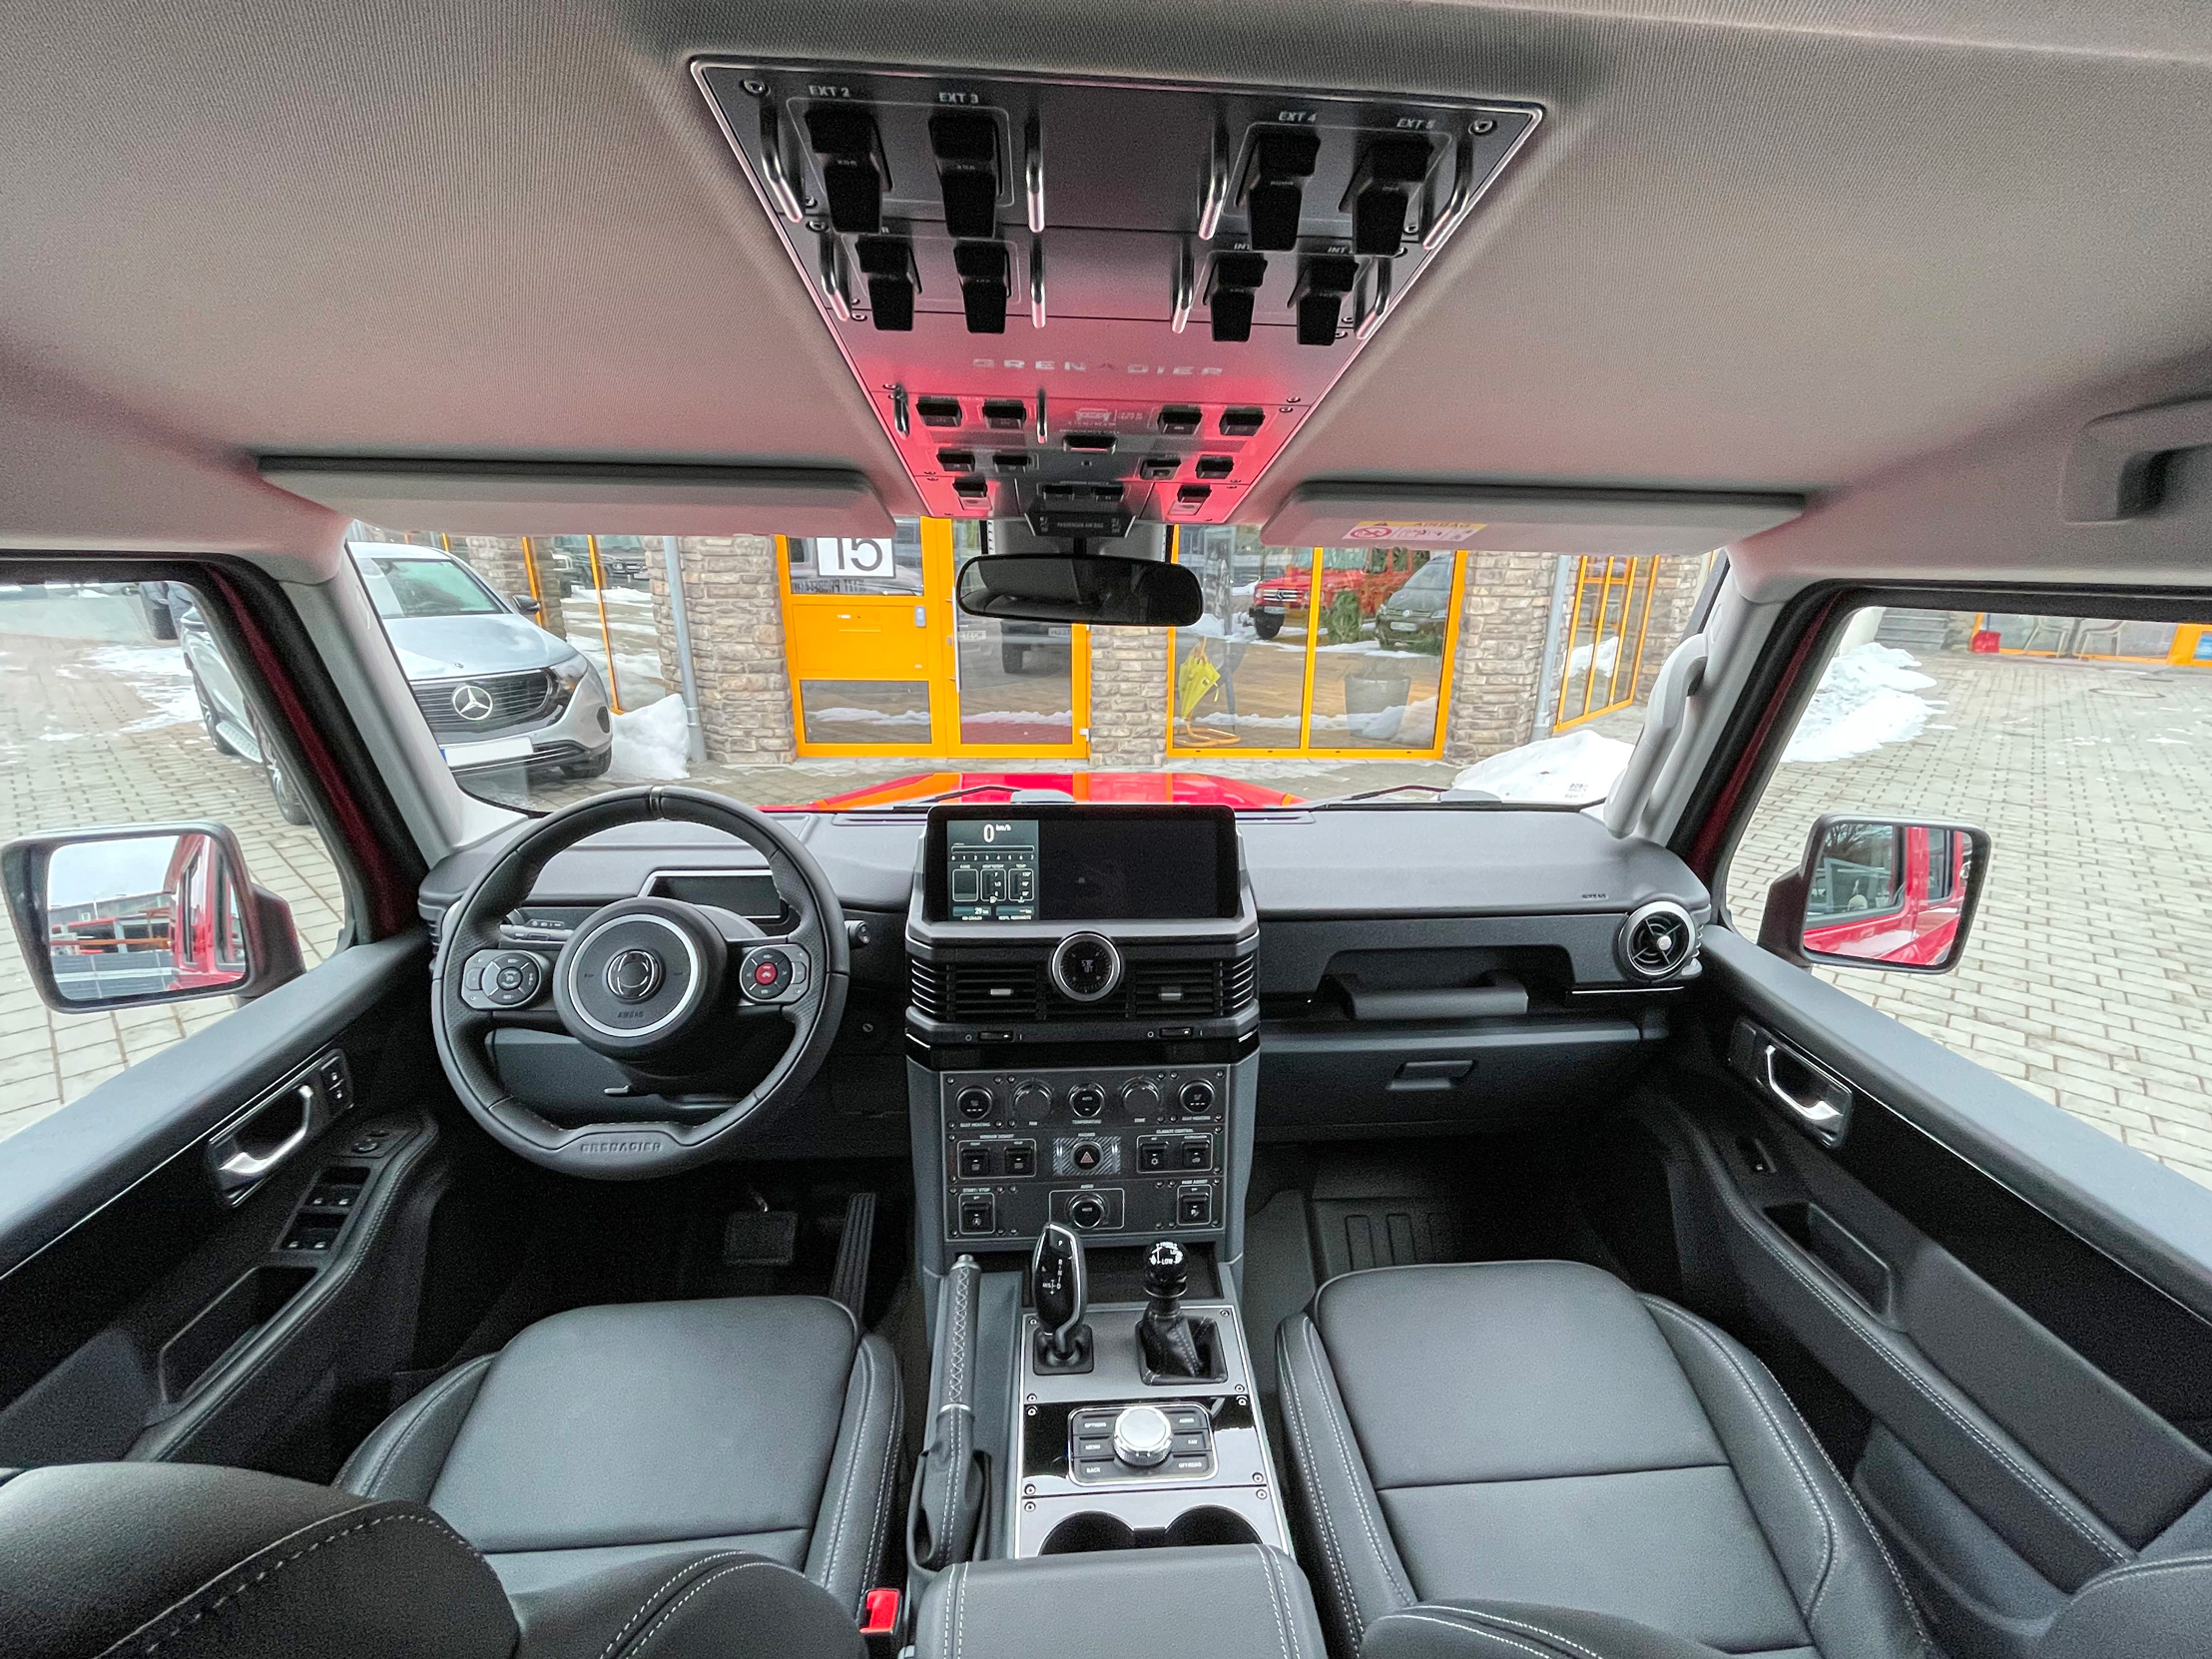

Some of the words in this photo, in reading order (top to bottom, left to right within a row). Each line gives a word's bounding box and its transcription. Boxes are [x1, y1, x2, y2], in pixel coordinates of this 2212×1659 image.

[808, 85, 837, 97] EXT
[840, 87, 849, 98] 2
[938, 92, 964, 104] EXT
[970, 94, 979, 104] 3
[1279, 111, 1307, 122] EXT
[1308, 113, 1317, 122] 4
[1396, 119, 1424, 130] EXT
[973, 358, 1223, 375] GRENADIER
[836, 538, 883, 572] 15
[983, 824, 995, 842] 0
[580, 1141, 662, 1153] GRENADIER
